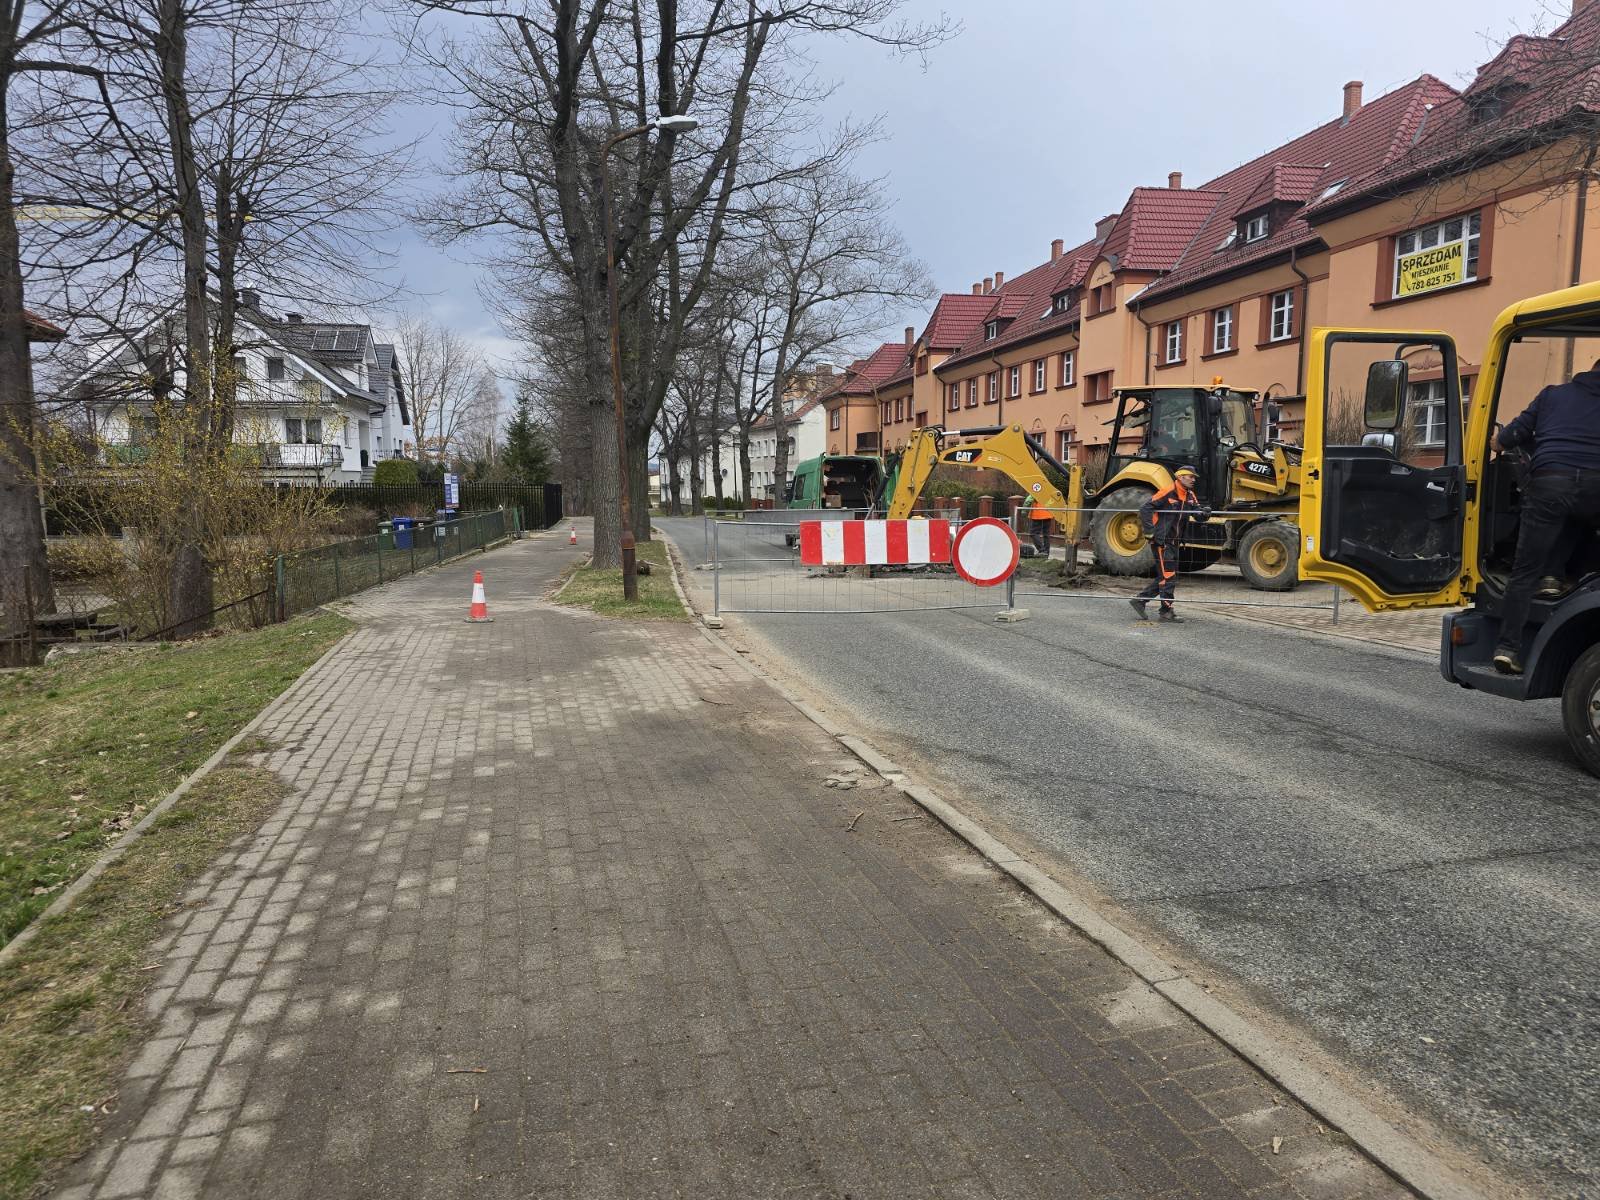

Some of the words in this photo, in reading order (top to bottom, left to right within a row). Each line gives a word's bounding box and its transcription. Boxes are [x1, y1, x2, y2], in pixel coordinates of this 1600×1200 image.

[1403, 245, 1461, 272] SPRZEDAM
[1412, 263, 1449, 278] MIESZKANIE
[1412, 281, 1424, 291] 782
[1426, 276, 1440, 286] 625
[956, 452, 972, 462] CAT
